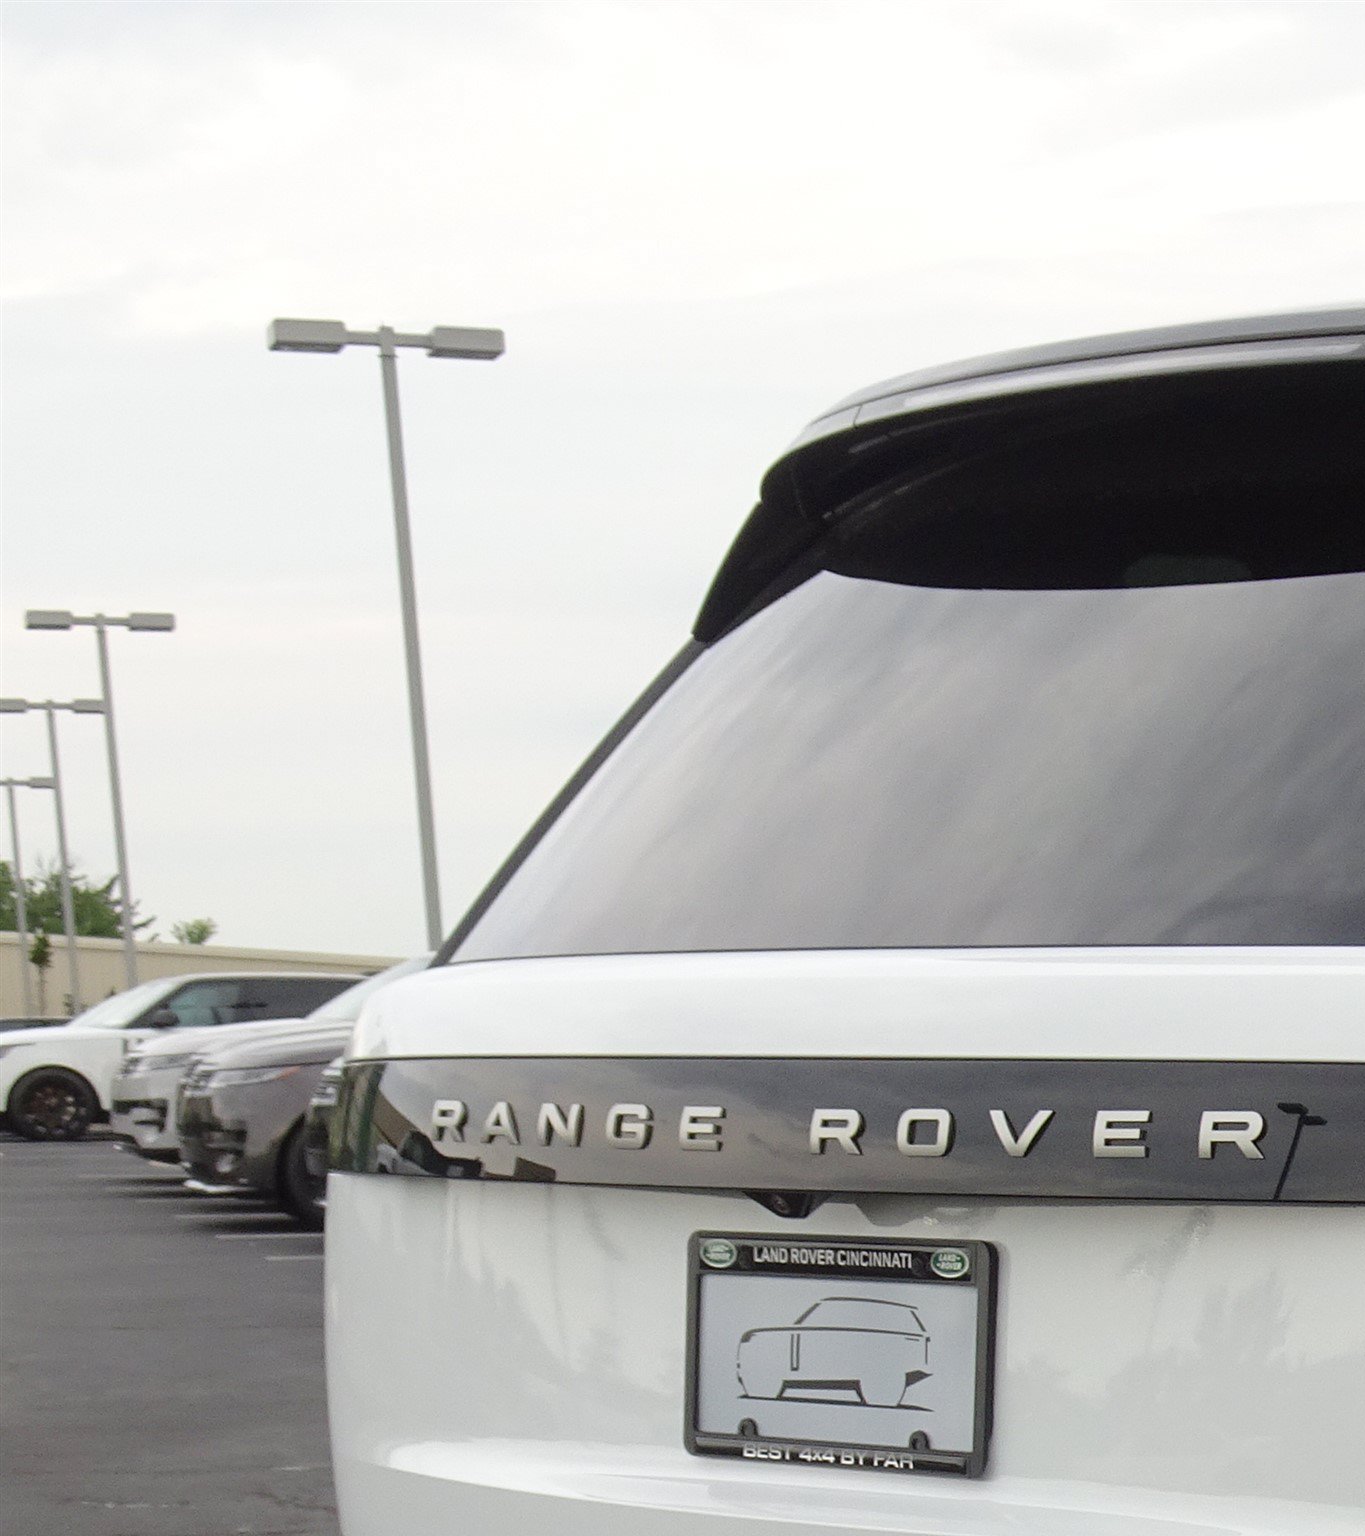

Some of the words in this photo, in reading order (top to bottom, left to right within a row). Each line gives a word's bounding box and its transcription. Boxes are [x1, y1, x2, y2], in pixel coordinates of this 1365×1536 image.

[429, 1099, 727, 1153] RANGE
[809, 1107, 1269, 1161] ROVER
[753, 1246, 787, 1263] LAND
[790, 1249, 835, 1265] ROVER
[836, 1250, 913, 1269] CINCINNATI
[743, 1443, 792, 1459] BEST
[839, 1449, 868, 1466] BY
[873, 1452, 914, 1470] FAR
